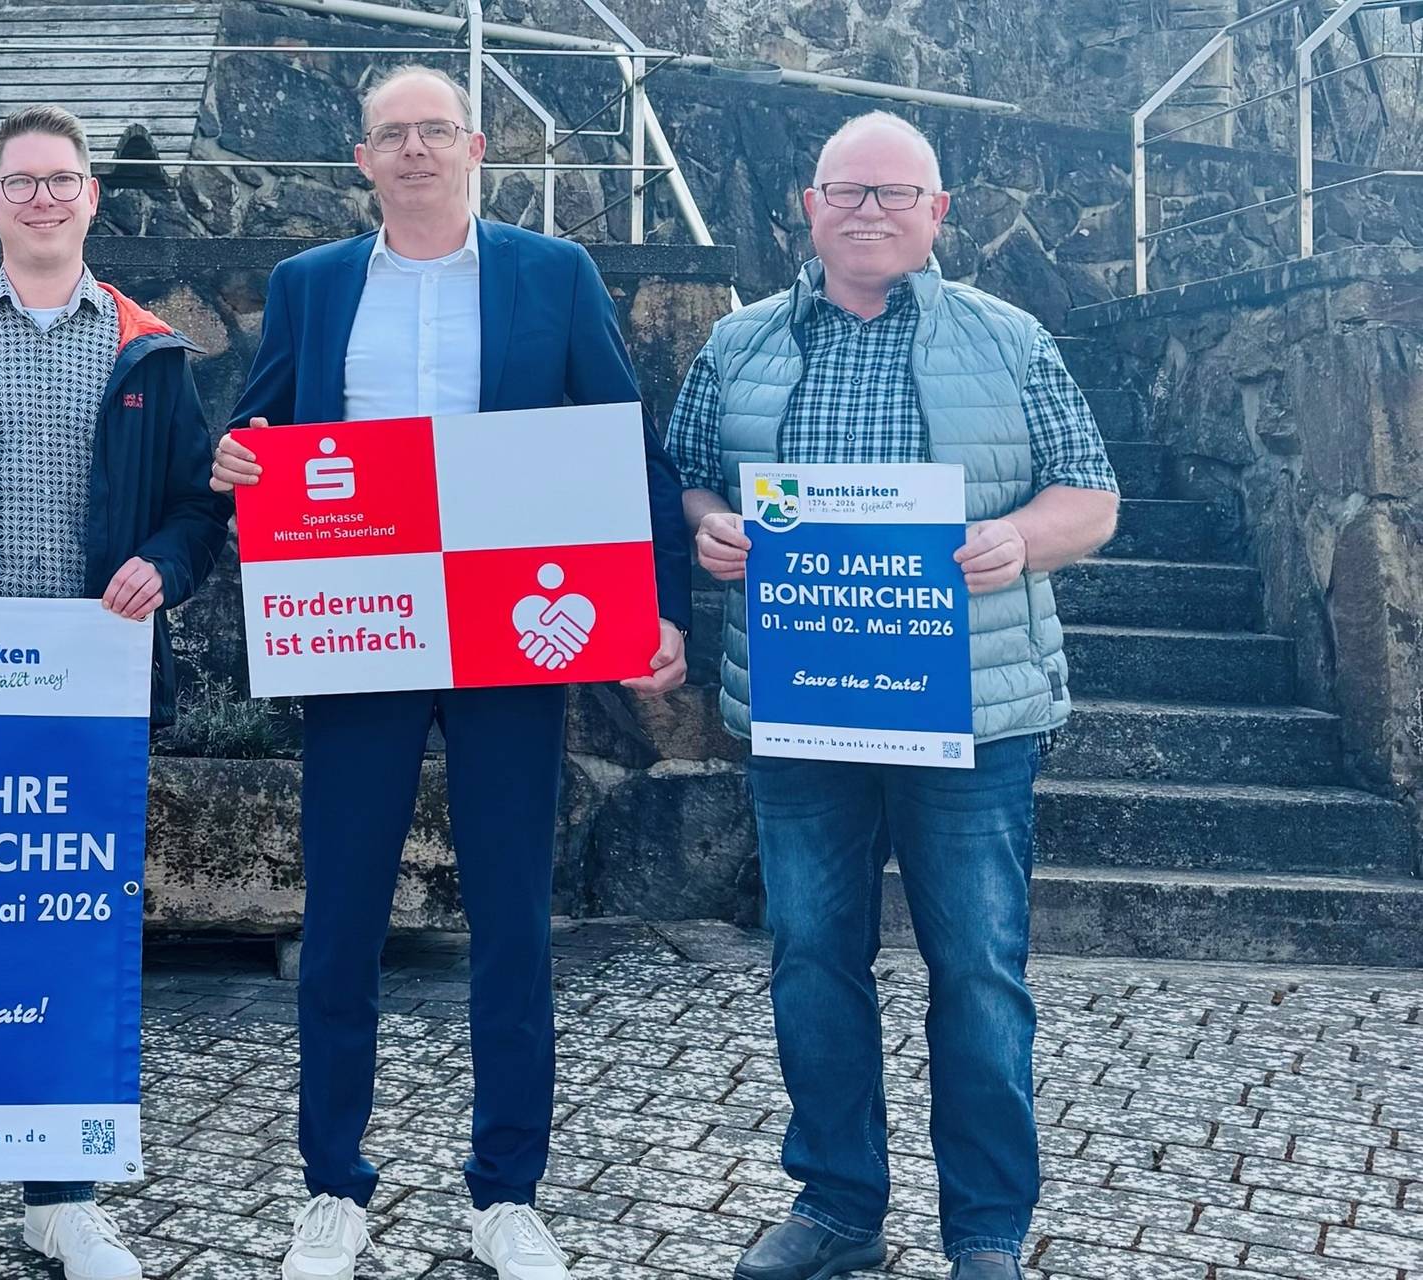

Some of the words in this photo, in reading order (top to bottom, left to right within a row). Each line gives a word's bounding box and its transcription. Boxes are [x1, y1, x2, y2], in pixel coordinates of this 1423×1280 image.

[807, 486, 899, 498] Buntkiärken
[302, 512, 364, 526] Sparkasse
[274, 530, 313, 542] Mitten
[316, 529, 331, 538] im
[334, 526, 395, 538] Sauerland
[785, 552, 830, 575] 750
[838, 554, 922, 576] JAHRE
[263, 592, 413, 618] Förderung
[759, 582, 953, 609] BONTKIRCHEN
[761, 614, 787, 630] 01.
[793, 615, 825, 632] und
[832, 618, 860, 634] 02.
[867, 618, 901, 635] Mai
[909, 620, 953, 636] 2026
[265, 632, 303, 656] ist
[311, 626, 425, 654] einfach.
[792, 670, 837, 686] Save
[841, 674, 870, 689] the
[873, 674, 928, 692] Date!
[38, 892, 111, 922] 2026
